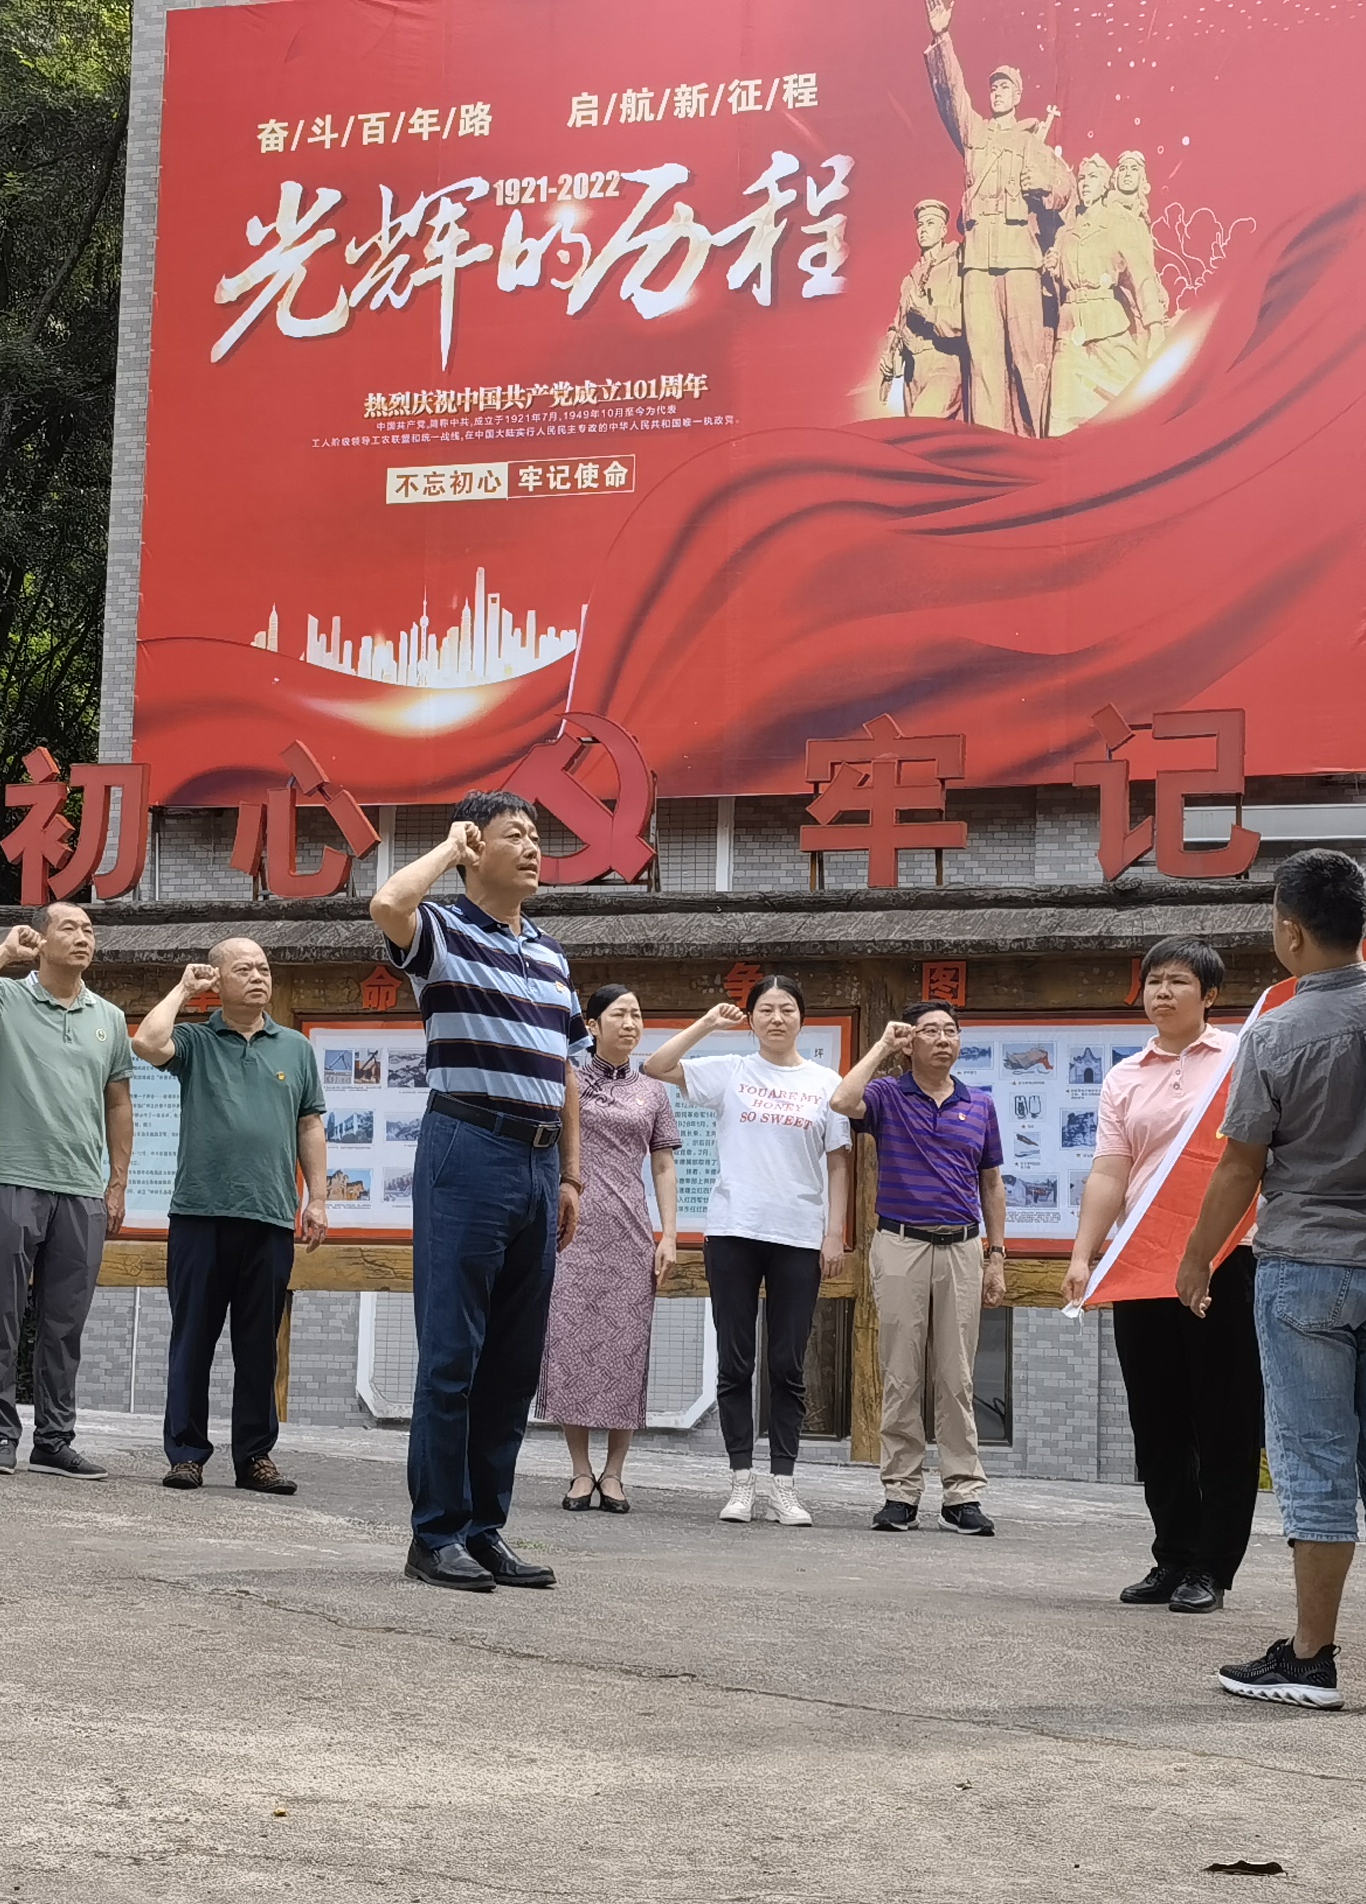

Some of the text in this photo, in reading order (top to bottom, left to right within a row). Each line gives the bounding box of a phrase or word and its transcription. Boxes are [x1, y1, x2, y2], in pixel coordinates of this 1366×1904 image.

[493, 170, 621, 207] 1921-2022
[209, 150, 856, 372] 光辉的历程
[363, 373, 709, 420] 热烈庆祝中国共产党成立101周年
[394, 460, 629, 497] 不忘初心 牢记使命
[360, 965, 403, 1012] 命
[922, 960, 967, 1007] 图
[814, 1048, 824, 1059] 坪
[739, 1111, 813, 1130] SO SWEET
[751, 1098, 805, 1112] HONEY
